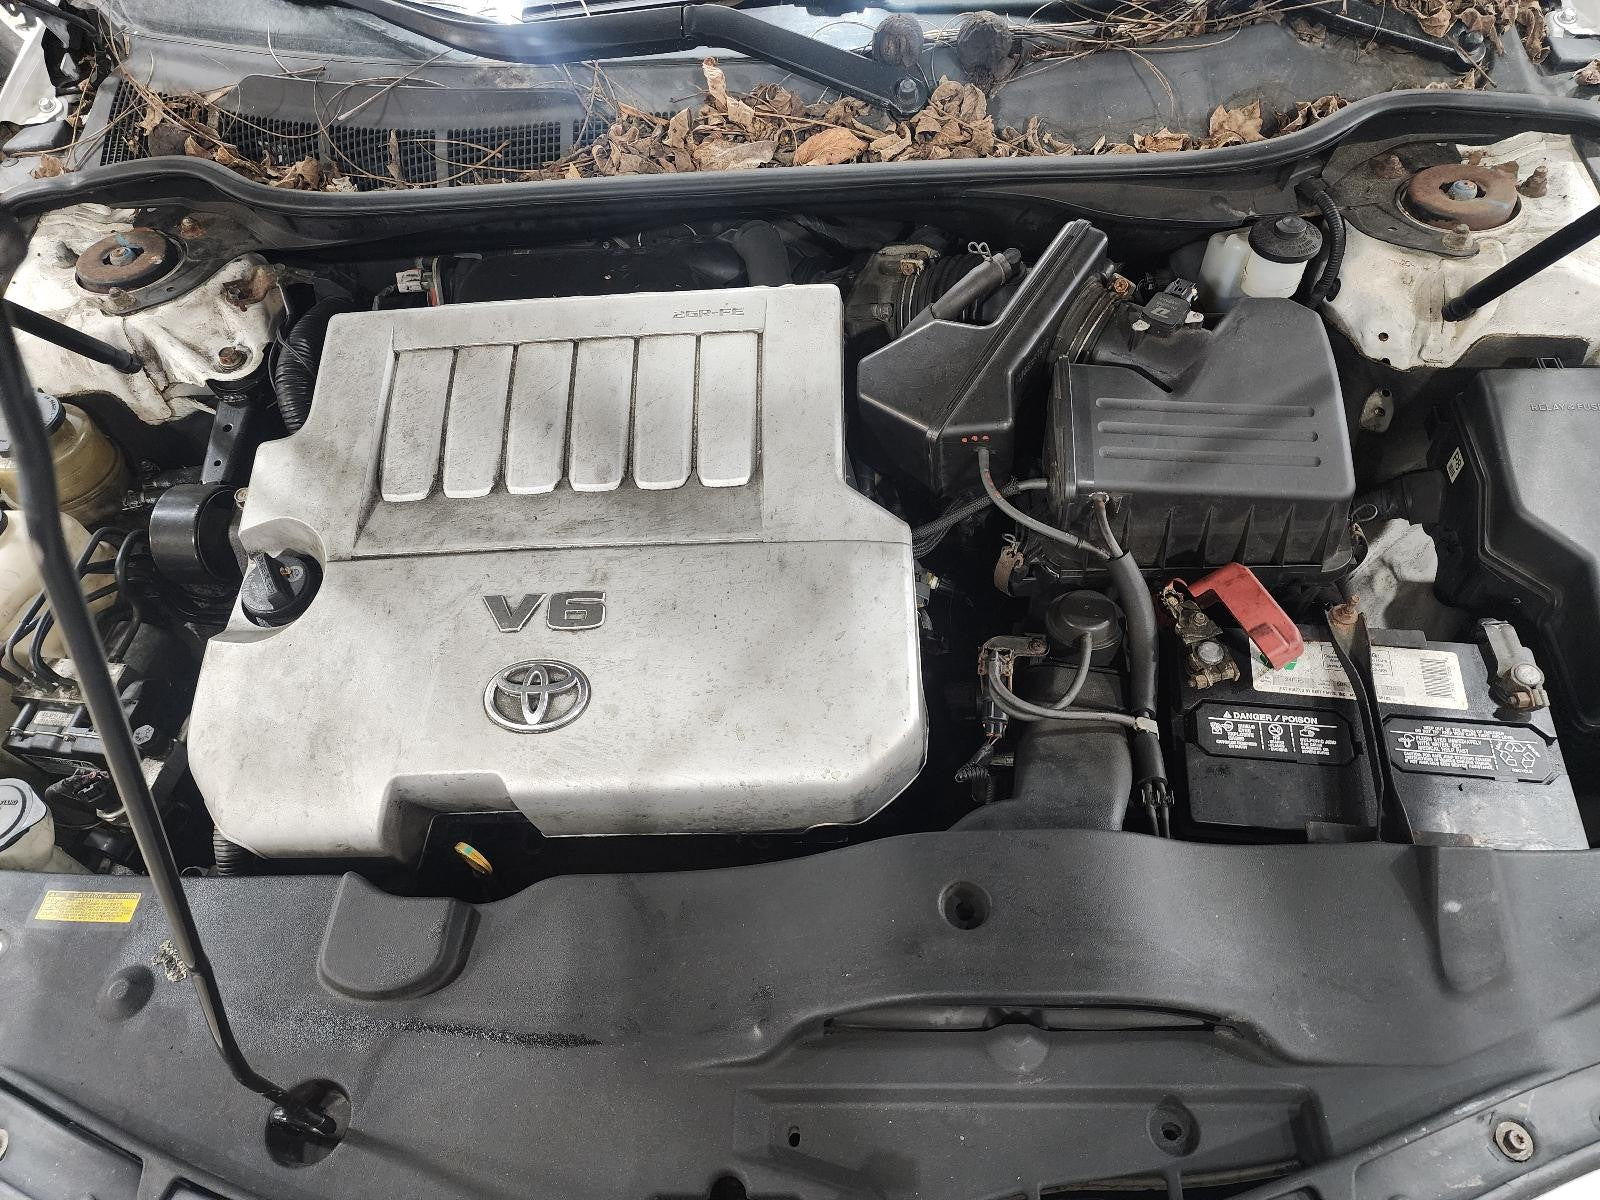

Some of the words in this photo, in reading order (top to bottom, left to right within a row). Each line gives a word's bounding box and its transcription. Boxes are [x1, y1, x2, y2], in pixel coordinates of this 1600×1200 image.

[1530, 403, 1565, 412] RELAY
[482, 591, 607, 633] V6
[1233, 711, 1272, 722] DANGER
[1282, 715, 1318, 724] POISON
